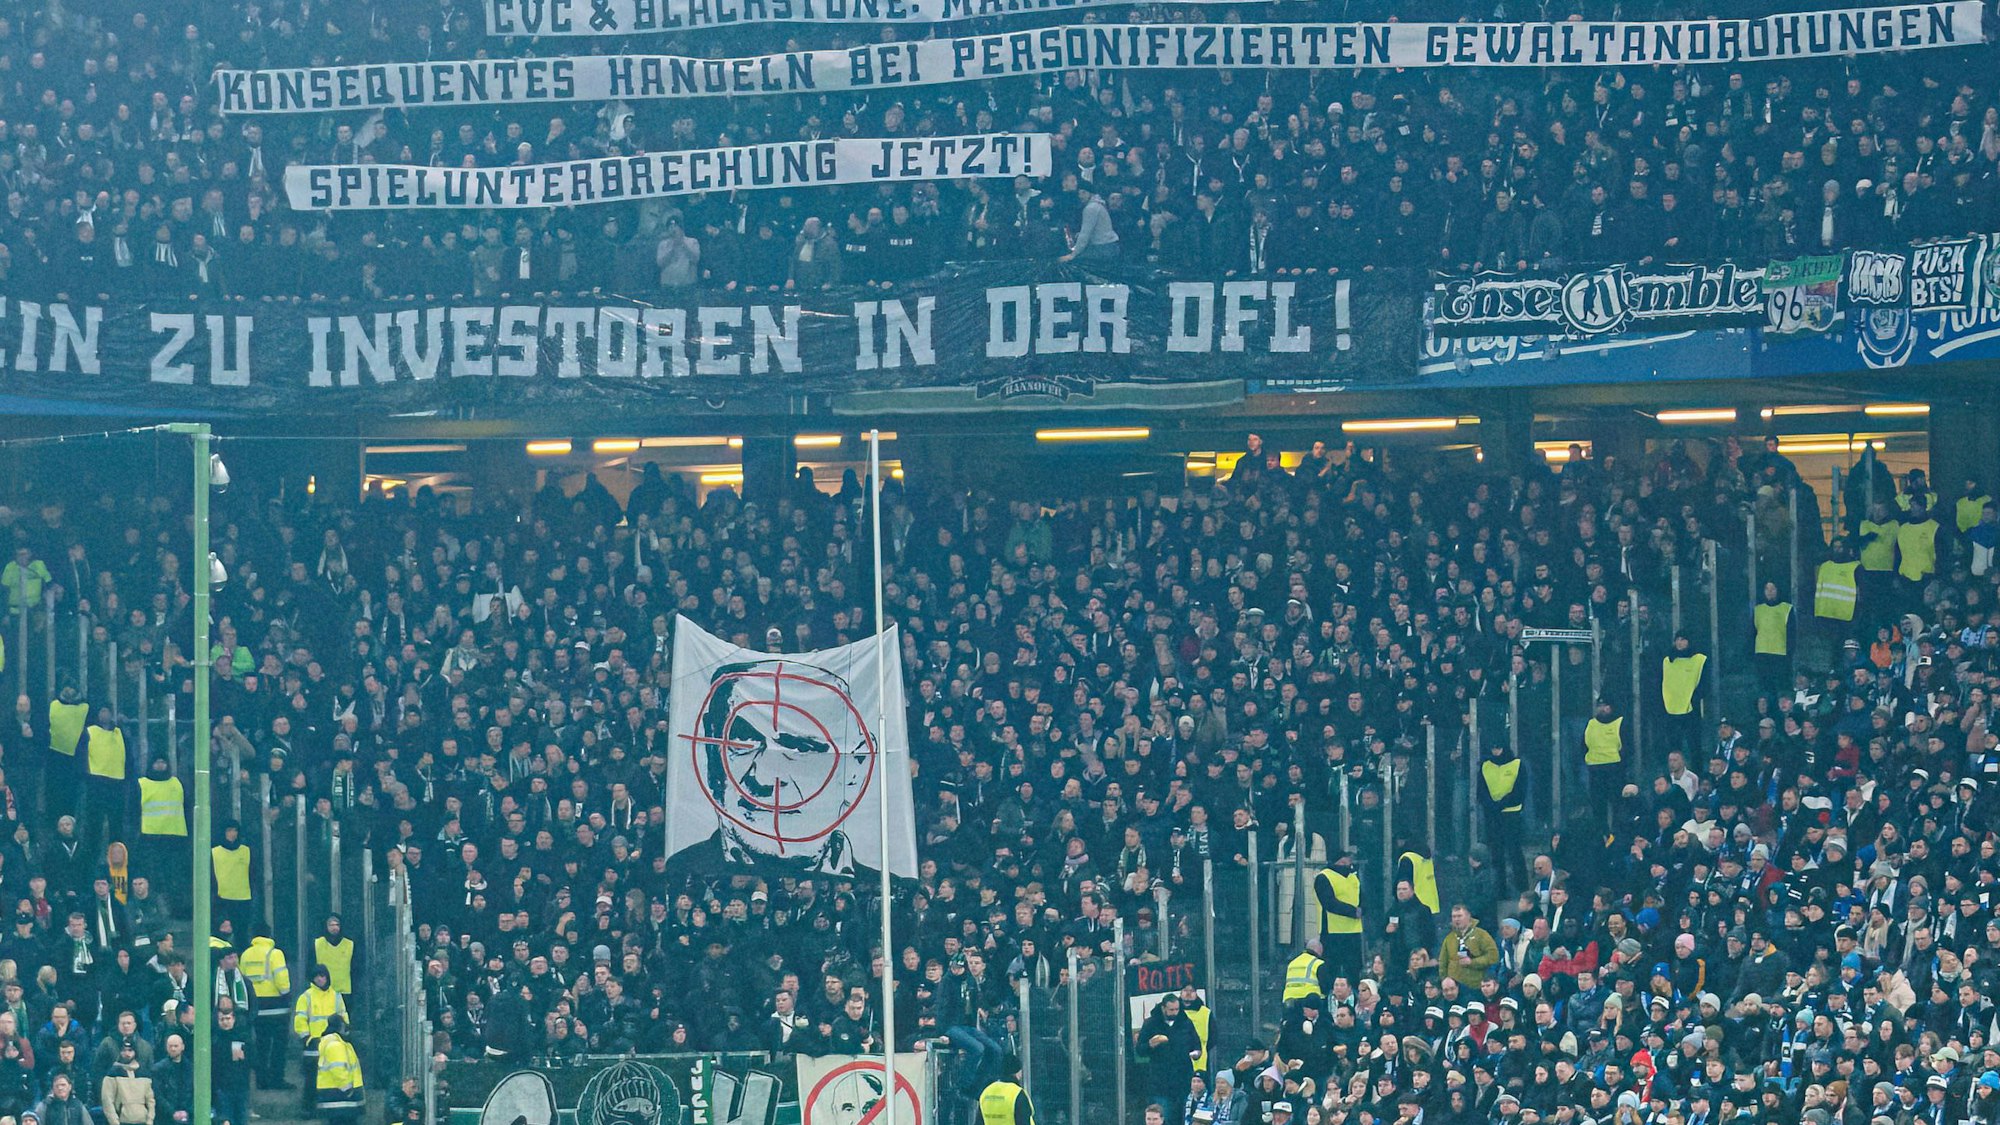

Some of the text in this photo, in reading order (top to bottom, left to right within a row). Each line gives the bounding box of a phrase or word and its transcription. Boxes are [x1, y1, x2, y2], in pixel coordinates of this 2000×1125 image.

[494, 0, 572, 33] CVC
[589, 0, 618, 31] &
[223, 4, 1955, 110] KONSEQUENTES HANDELN BEI PERSONIFIZIERTEN GEWALTANDROHUNGEN
[311, 136, 1032, 208] SPIELUNTERBRECHUNG JETZT!
[1911, 243, 1968, 276] FUCK
[1773, 286, 1803, 331] 96
[0, 279, 1351, 387] IN ZU INVESTOREN IN DER DFL !
[1005, 380, 1062, 396] HANNOVER
